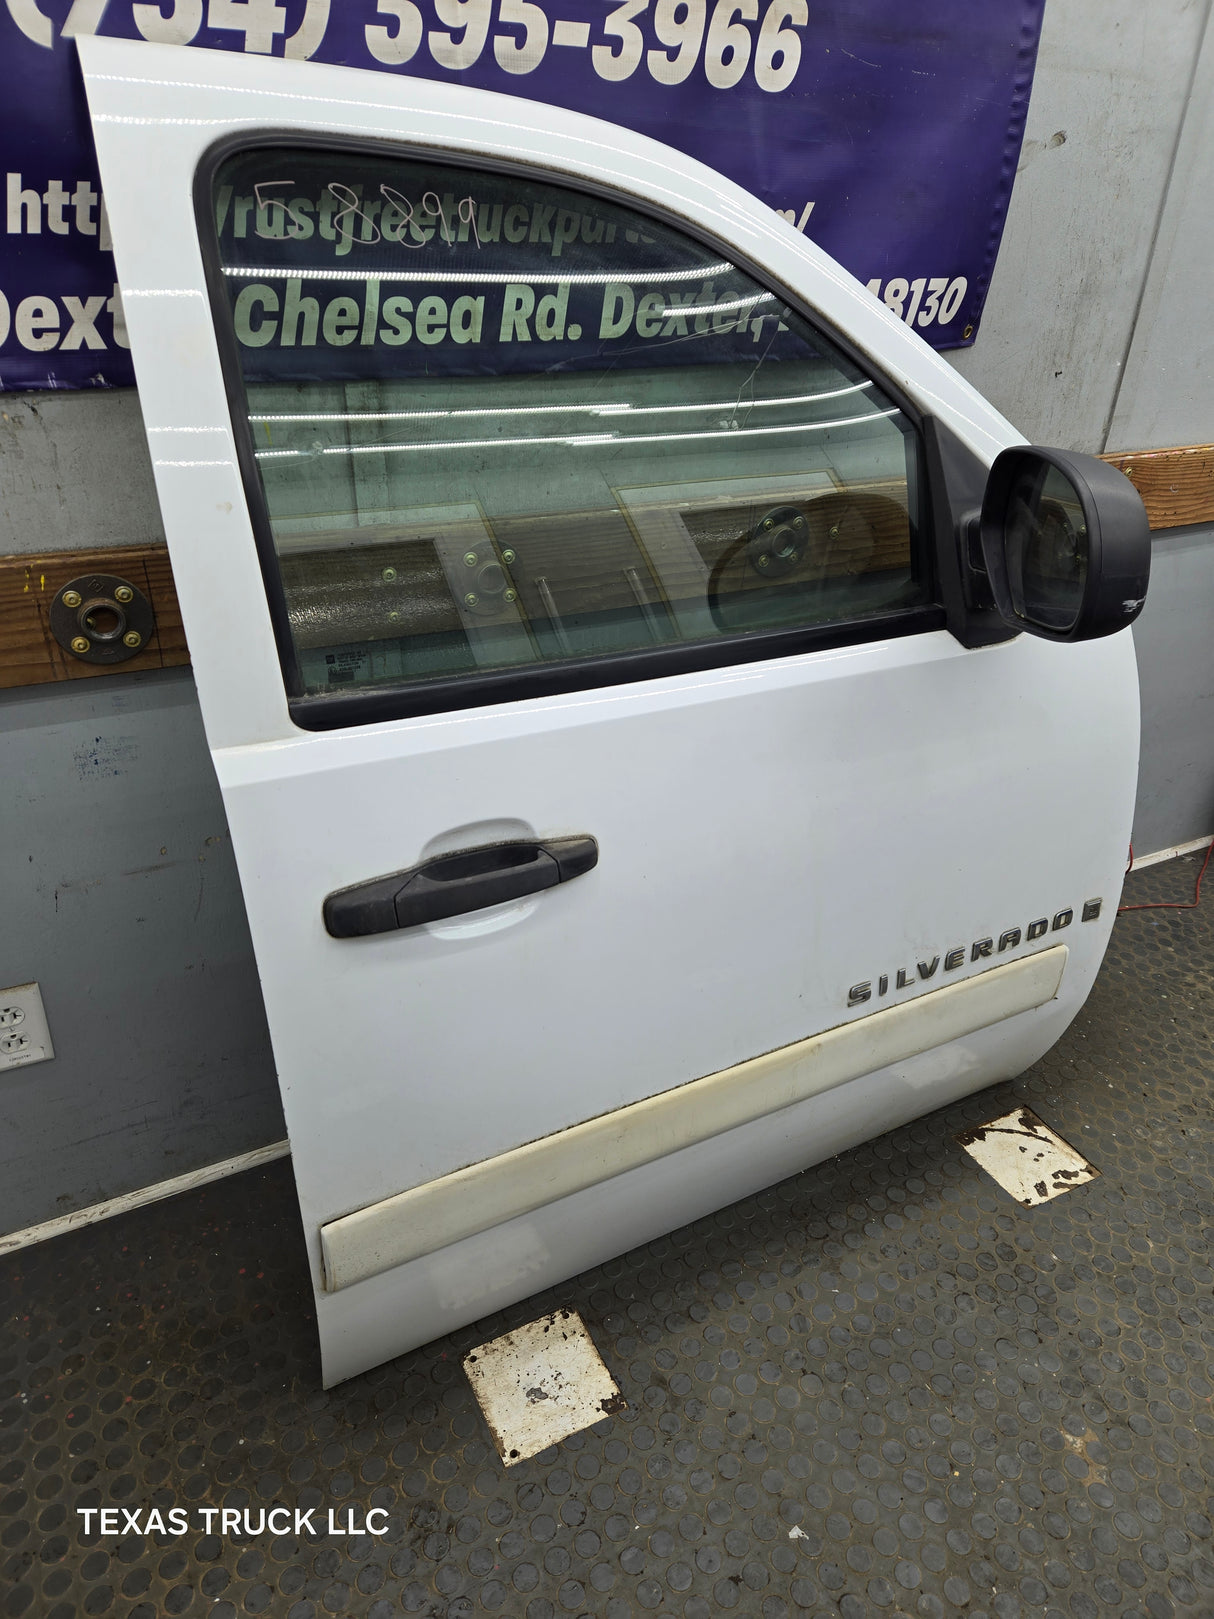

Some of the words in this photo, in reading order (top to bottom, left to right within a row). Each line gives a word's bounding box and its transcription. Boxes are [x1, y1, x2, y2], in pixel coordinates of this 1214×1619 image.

[365, 0, 809, 93] 395-3966
[233, 279, 486, 348] Chelsea
[499, 282, 582, 342] Rd.
[847, 907, 1073, 1007] SILVERADO
